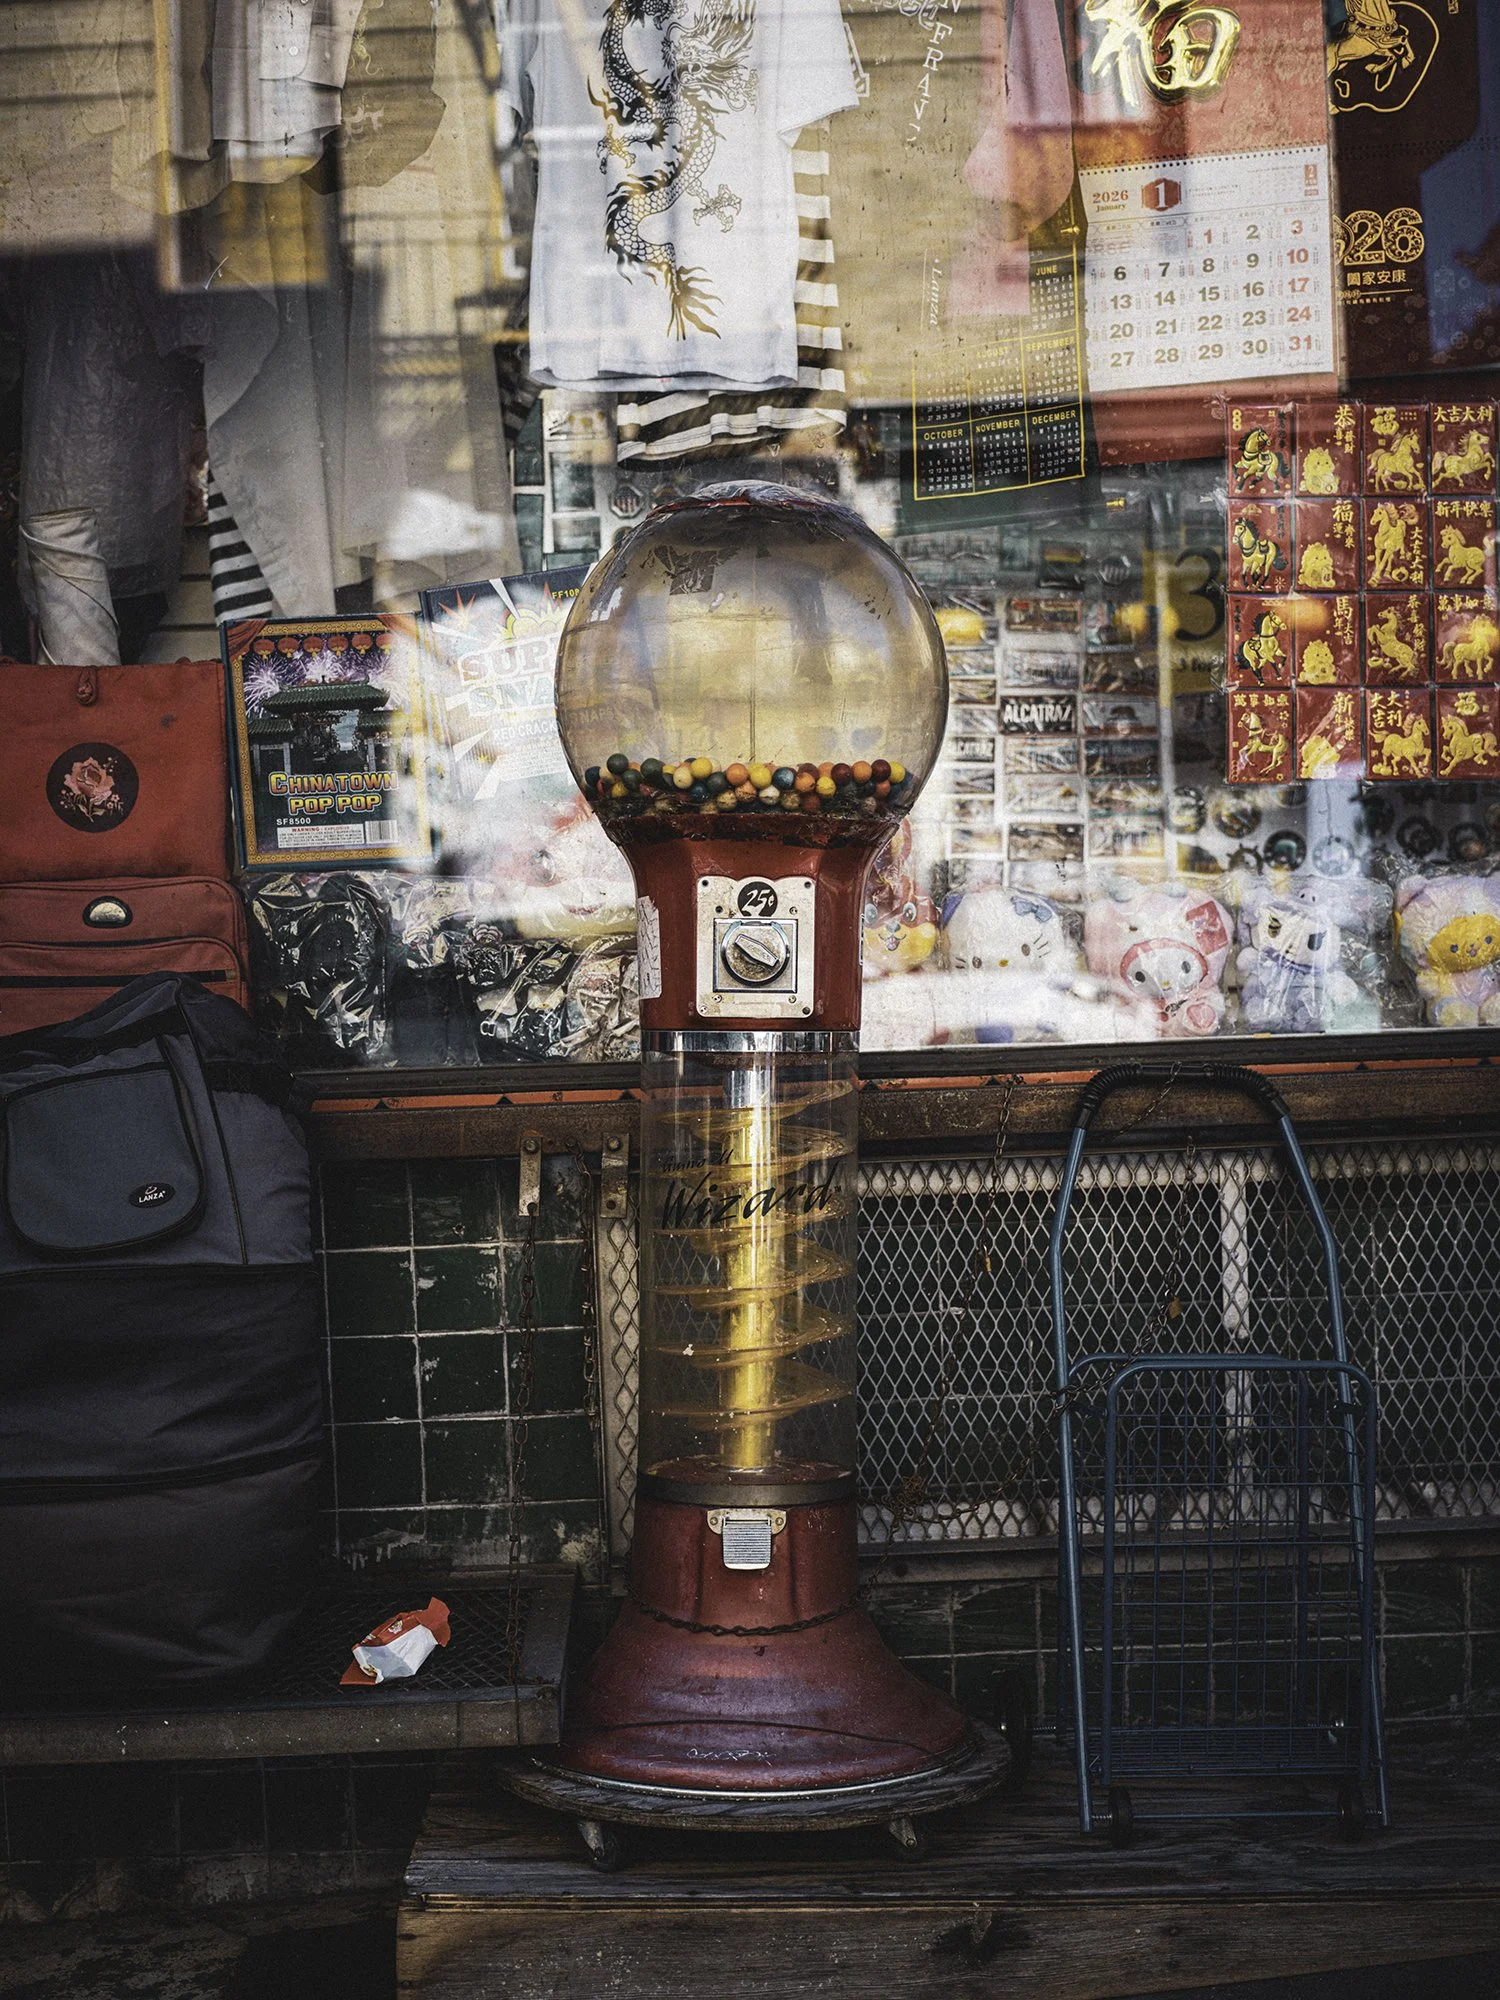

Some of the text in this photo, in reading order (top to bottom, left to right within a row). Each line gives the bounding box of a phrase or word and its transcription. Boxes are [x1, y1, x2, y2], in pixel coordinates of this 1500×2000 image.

[1092, 190, 1129, 204] 2026
[1154, 182, 1168, 209] 1
[1095, 203, 1126, 213] January
[1203, 220, 1303, 244] 1 2 3
[1036, 265, 1058, 276] JUNE
[1114, 249, 1309, 281] 6 7 8 9 10
[929, 267, 943, 326] Lanza
[1110, 277, 1310, 310] 13 14 15 16 17
[1110, 306, 1312, 339] 20 21 22 23 24
[1110, 336, 1312, 368] 27 28 29 30 31
[1032, 410, 1076, 424] DECEMBER
[1434, 405, 1494, 422] 大吉大利
[924, 428, 964, 440] OCTOBER
[976, 419, 1020, 432] NOVEMBER
[1410, 526, 1423, 584] 大吉大利
[460, 638, 560, 681] SUP
[1003, 703, 1072, 724] ALCATRAZ
[288, 793, 382, 815] POP POP
[276, 818, 311, 826] SF8500
[741, 889, 775, 912] 25¢
[138, 1191, 164, 1203] LANZA
